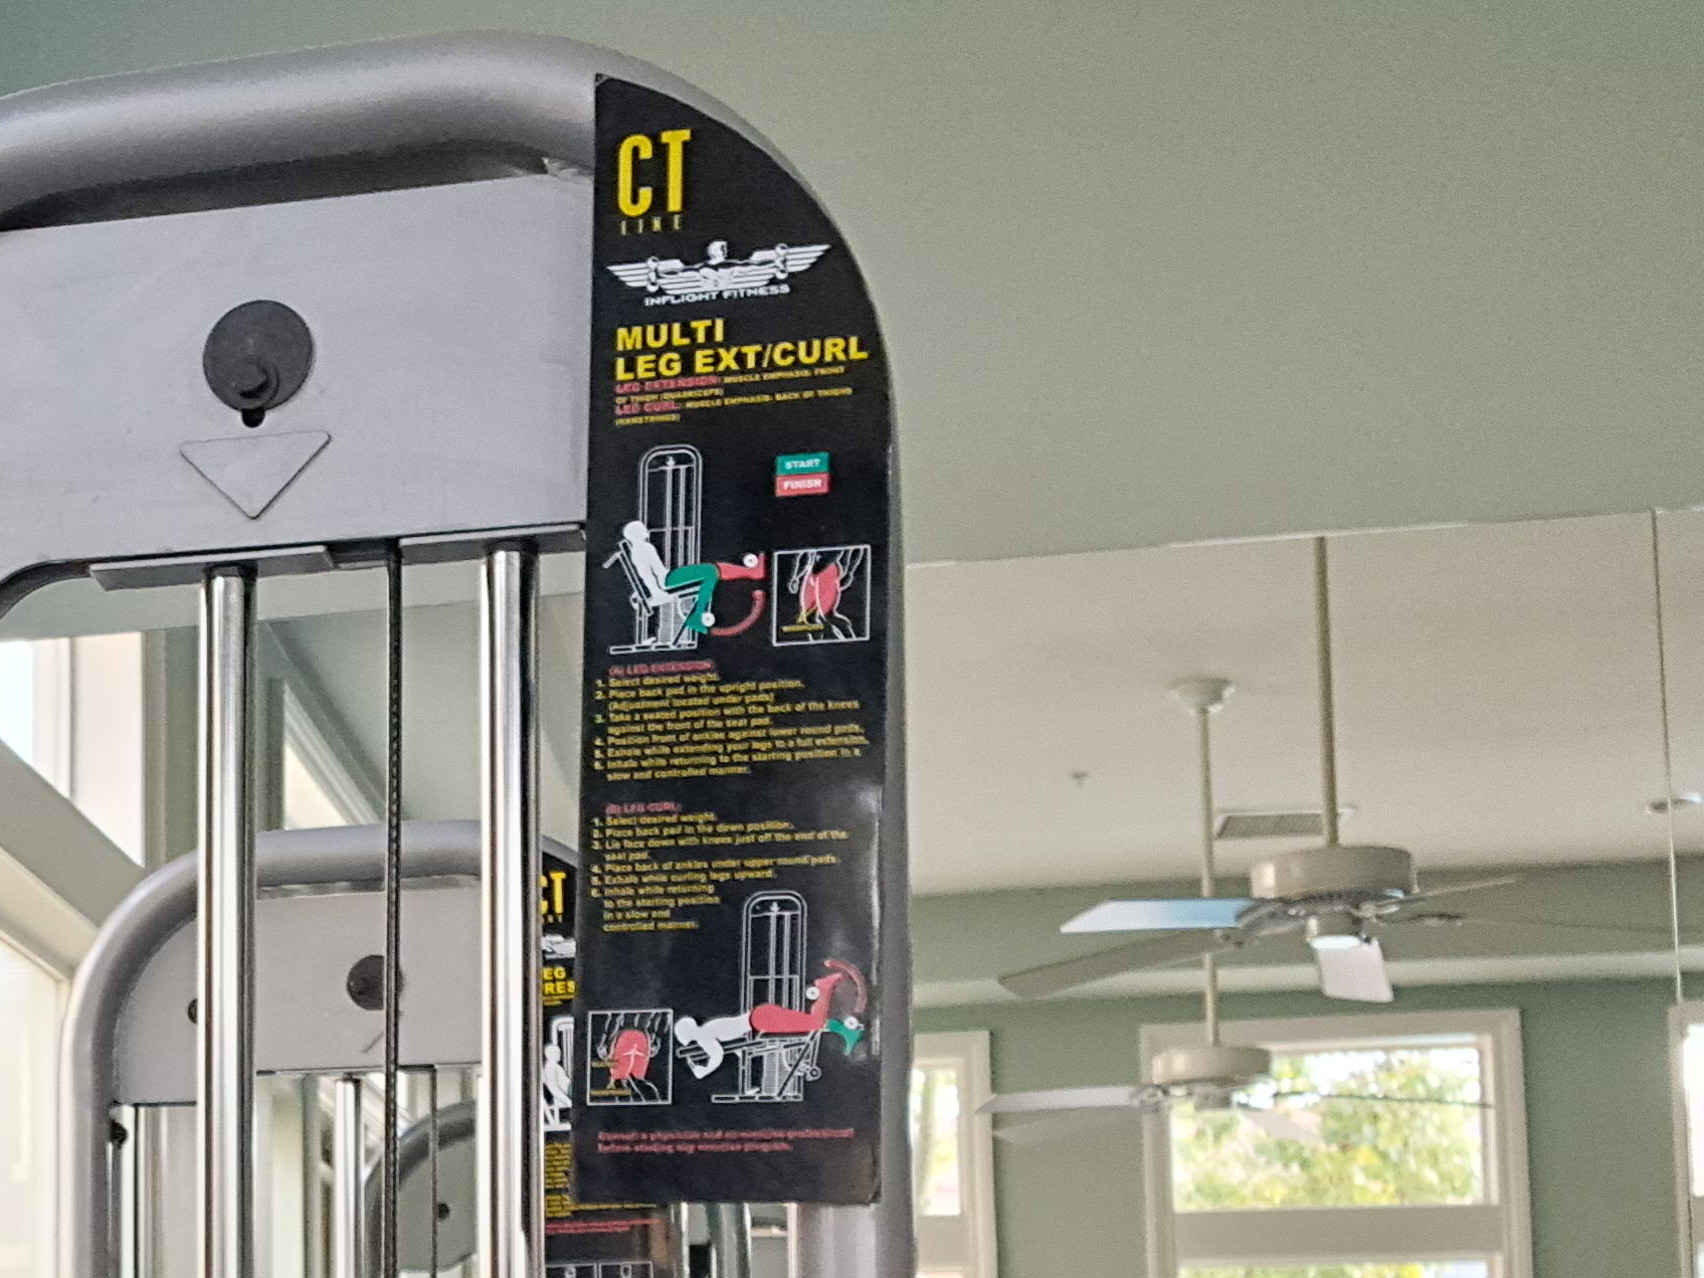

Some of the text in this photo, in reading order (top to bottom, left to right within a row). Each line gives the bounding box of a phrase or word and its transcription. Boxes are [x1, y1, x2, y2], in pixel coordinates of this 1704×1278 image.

[618, 129, 692, 217] CT
[644, 284, 790, 307] INFLIGHT FITNESS
[615, 317, 726, 351] MULTI
[614, 336, 870, 382] LEG EXT/CURL
[785, 458, 821, 470] START
[784, 478, 822, 491] FINISH
[608, 678, 641, 688] Select
[595, 690, 606, 700] 2.
[608, 689, 636, 699] Place
[638, 687, 663, 698] back
[665, 686, 686, 697] pad
[699, 683, 716, 694] the
[608, 712, 632, 723] Take
[679, 708, 721, 720] position
[723, 705, 746, 716] with
[747, 704, 766, 715] the
[647, 722, 665, 733] the
[693, 719, 705, 730] of
[706, 718, 724, 729] the
[718, 754, 731, 764] to
[732, 753, 749, 764] the
[605, 827, 634, 839] Place
[635, 826, 660, 837] back
[662, 824, 682, 837] pad
[696, 823, 714, 834] the
[542, 966, 567, 980] EG
